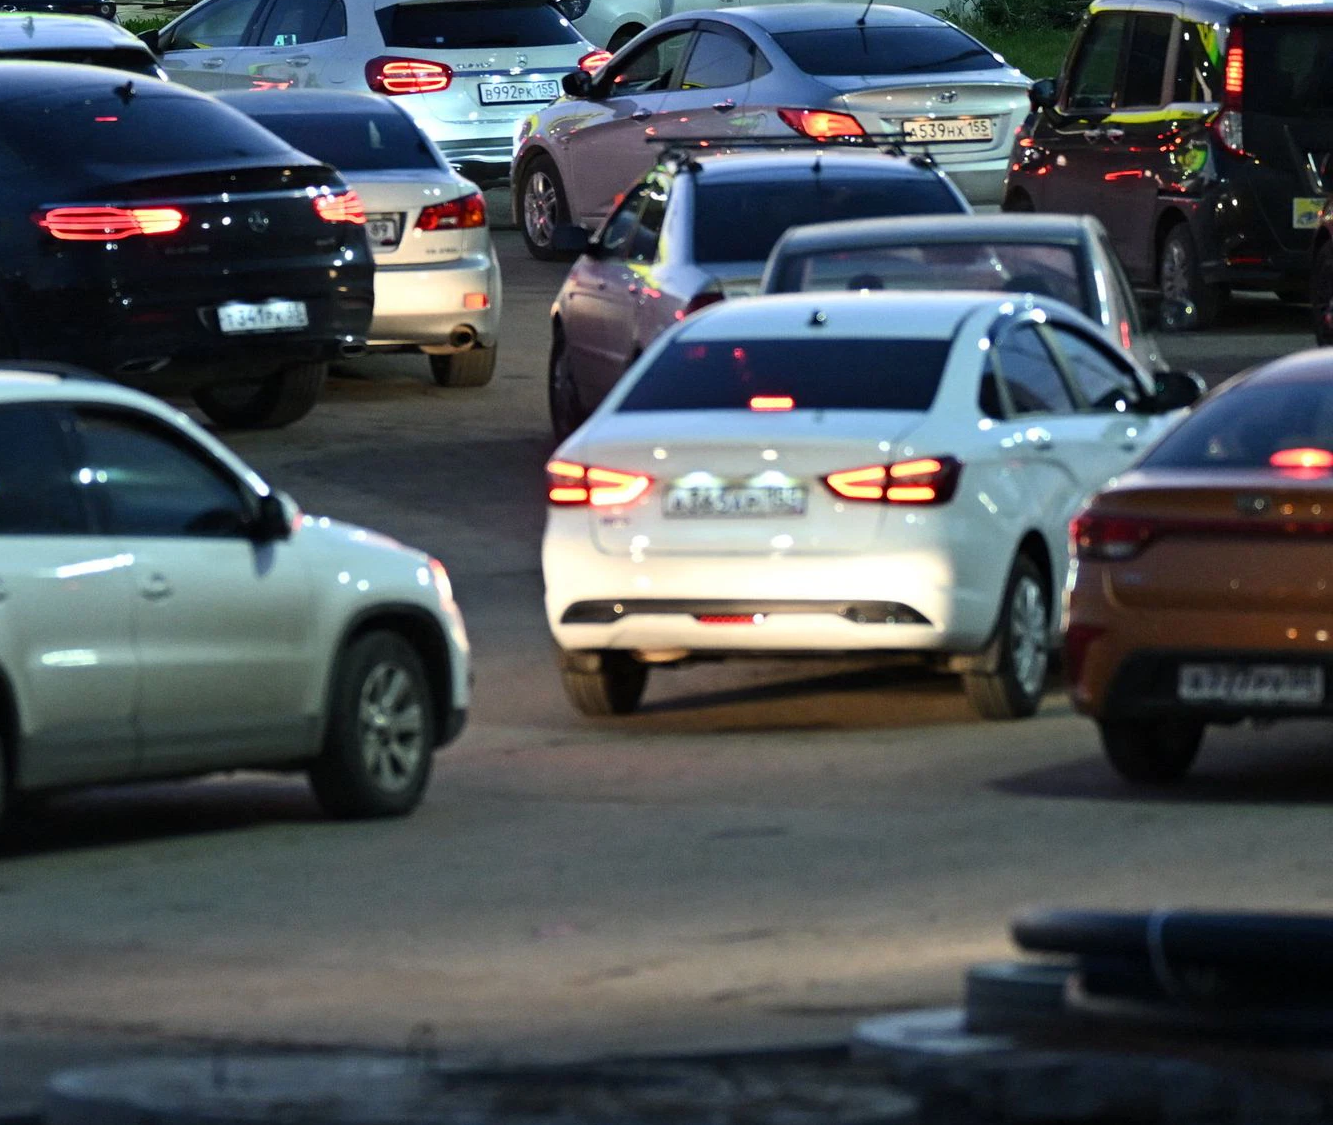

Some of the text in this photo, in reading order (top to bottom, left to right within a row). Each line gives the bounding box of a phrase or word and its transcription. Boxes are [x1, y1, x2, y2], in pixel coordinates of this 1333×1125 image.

[485, 83, 554, 100] В992РК 155
[910, 121, 988, 138] А539НХ 155
